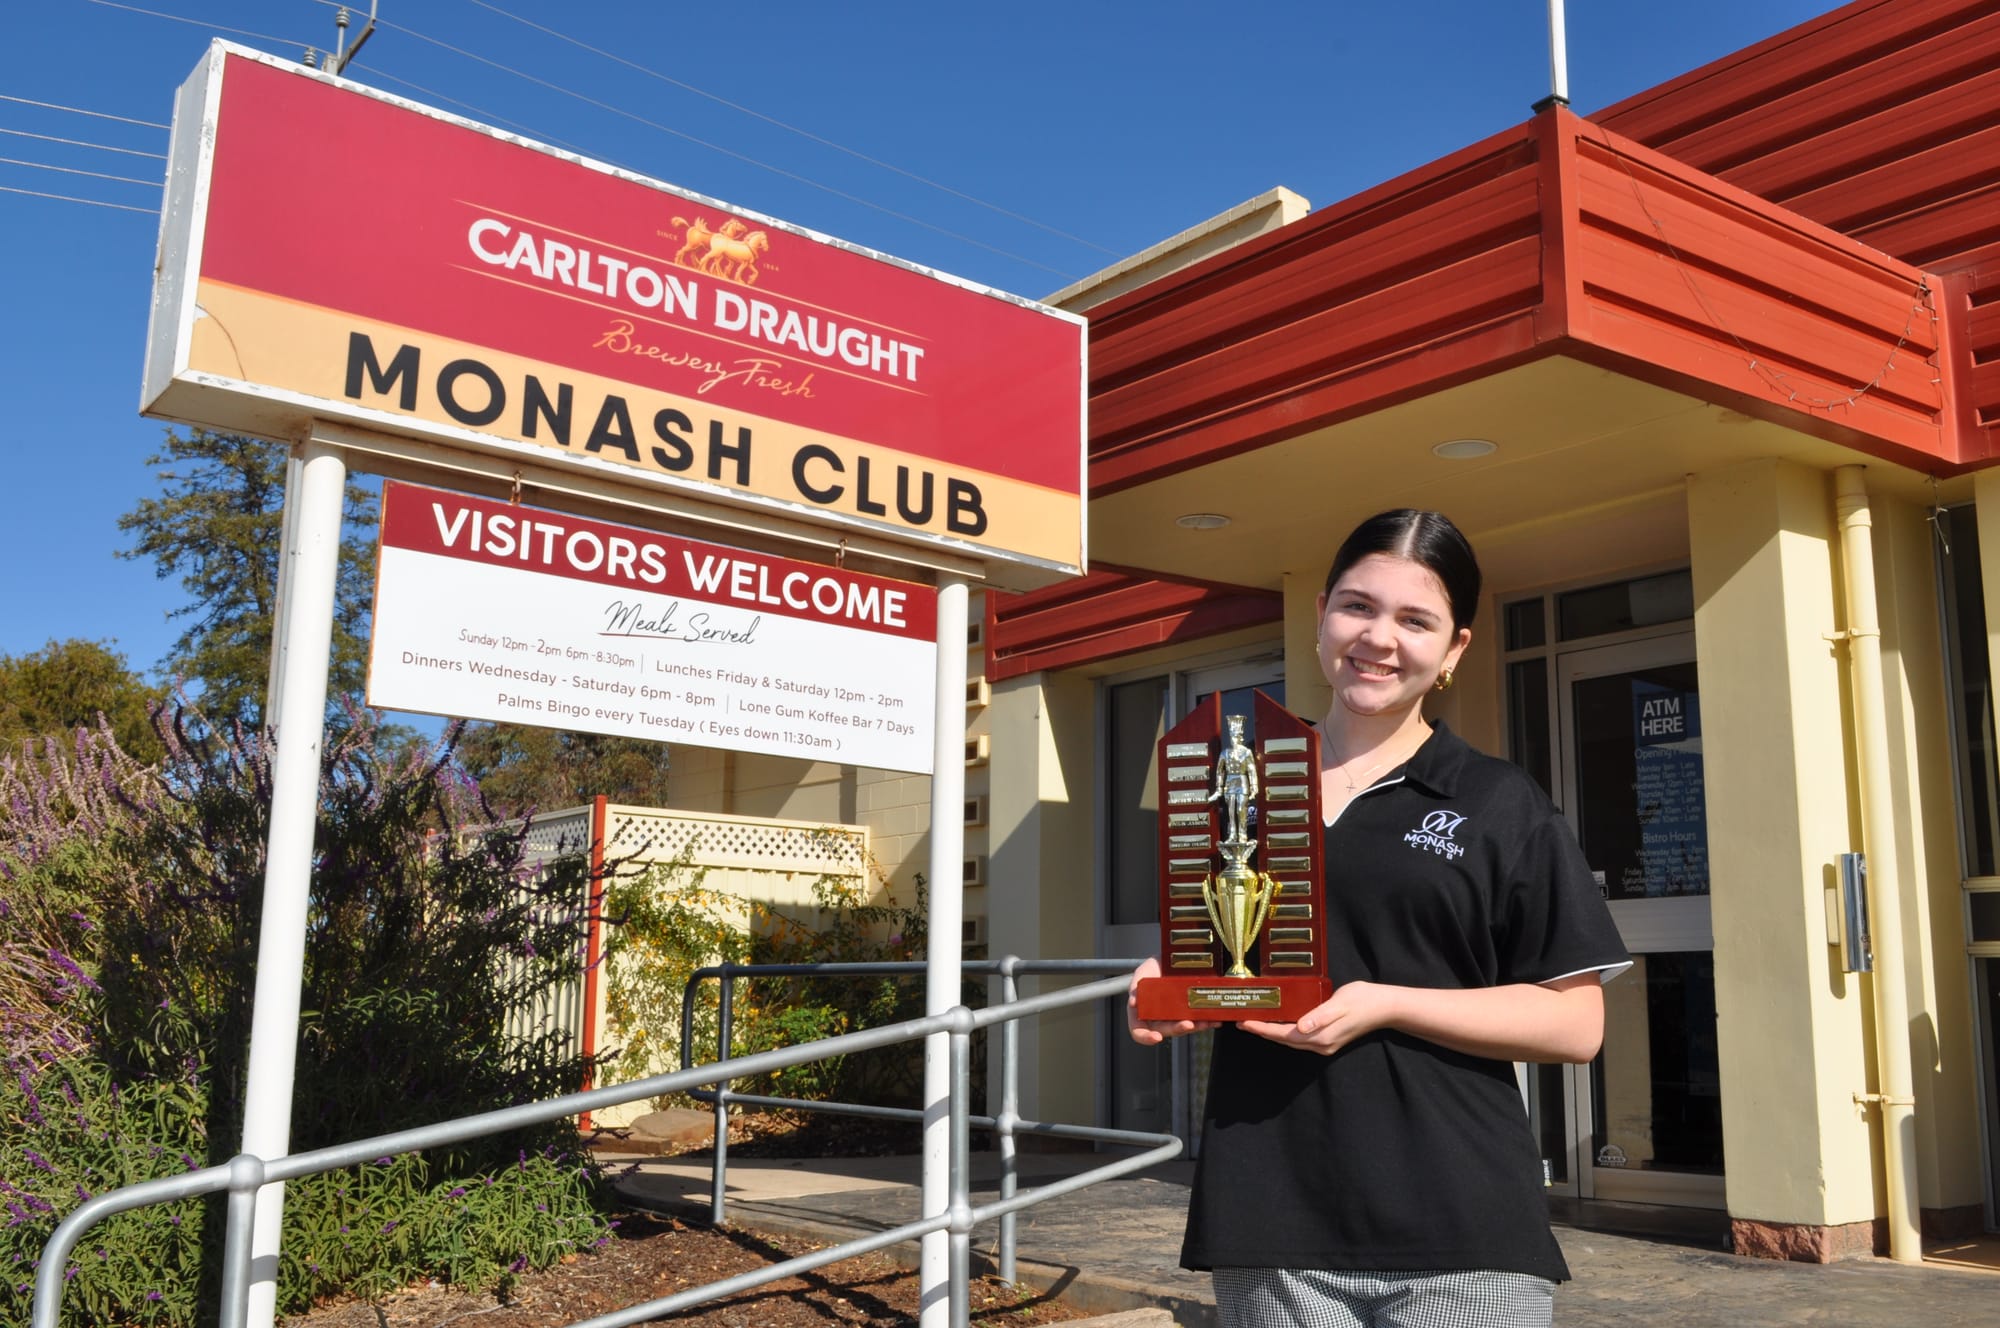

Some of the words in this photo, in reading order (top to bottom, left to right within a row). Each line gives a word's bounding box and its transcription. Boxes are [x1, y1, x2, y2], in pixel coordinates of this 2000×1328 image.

[656, 228, 678, 241] SINCE
[467, 218, 698, 321] CARLTON
[713, 287, 925, 382] DRAUGHT
[592, 320, 732, 394] Brewery
[731, 356, 816, 399] Fresh
[344, 331, 752, 486] MONASH
[791, 443, 988, 537] CLUB
[431, 502, 667, 584] VISITORS
[683, 549, 907, 628] WELCOME
[604, 600, 678, 637] Meals
[682, 612, 761, 645] Served
[458, 628, 499, 648] Sunday
[502, 636, 528, 652] 12pm
[566, 646, 589, 661] 6pm
[402, 651, 463, 672] Dinners
[468, 660, 558, 686] Wednesday
[572, 675, 636, 697] Saturday
[640, 685, 671, 703] 6pm
[685, 691, 715, 708] 8pm
[656, 660, 712, 680] Lunches
[717, 669, 758, 689] Friday
[761, 676, 771, 688] &
[774, 678, 830, 699] Saturday
[834, 688, 866, 704] 12pm
[878, 694, 904, 709] 2pm
[497, 693, 542, 711] Palms
[548, 700, 590, 718] Bingo
[594, 709, 634, 725] every
[639, 711, 696, 732] Tuesday
[709, 721, 740, 738] Eyes
[743, 726, 779, 742] down
[784, 730, 832, 749] 11:30am
[739, 700, 771, 715] Lone
[775, 705, 804, 720] Gum
[808, 709, 849, 726] Koffee
[852, 716, 872, 729] Bar
[876, 719, 883, 730] 7
[887, 721, 915, 736] Days
[1640, 716, 1684, 737] HERE
[1641, 697, 1680, 718] ATM
[1403, 833, 1465, 857] MONASH
[1411, 842, 1454, 860] CLUB
[1642, 832, 1668, 844] Bistro
[1670, 831, 1697, 843] Hours
